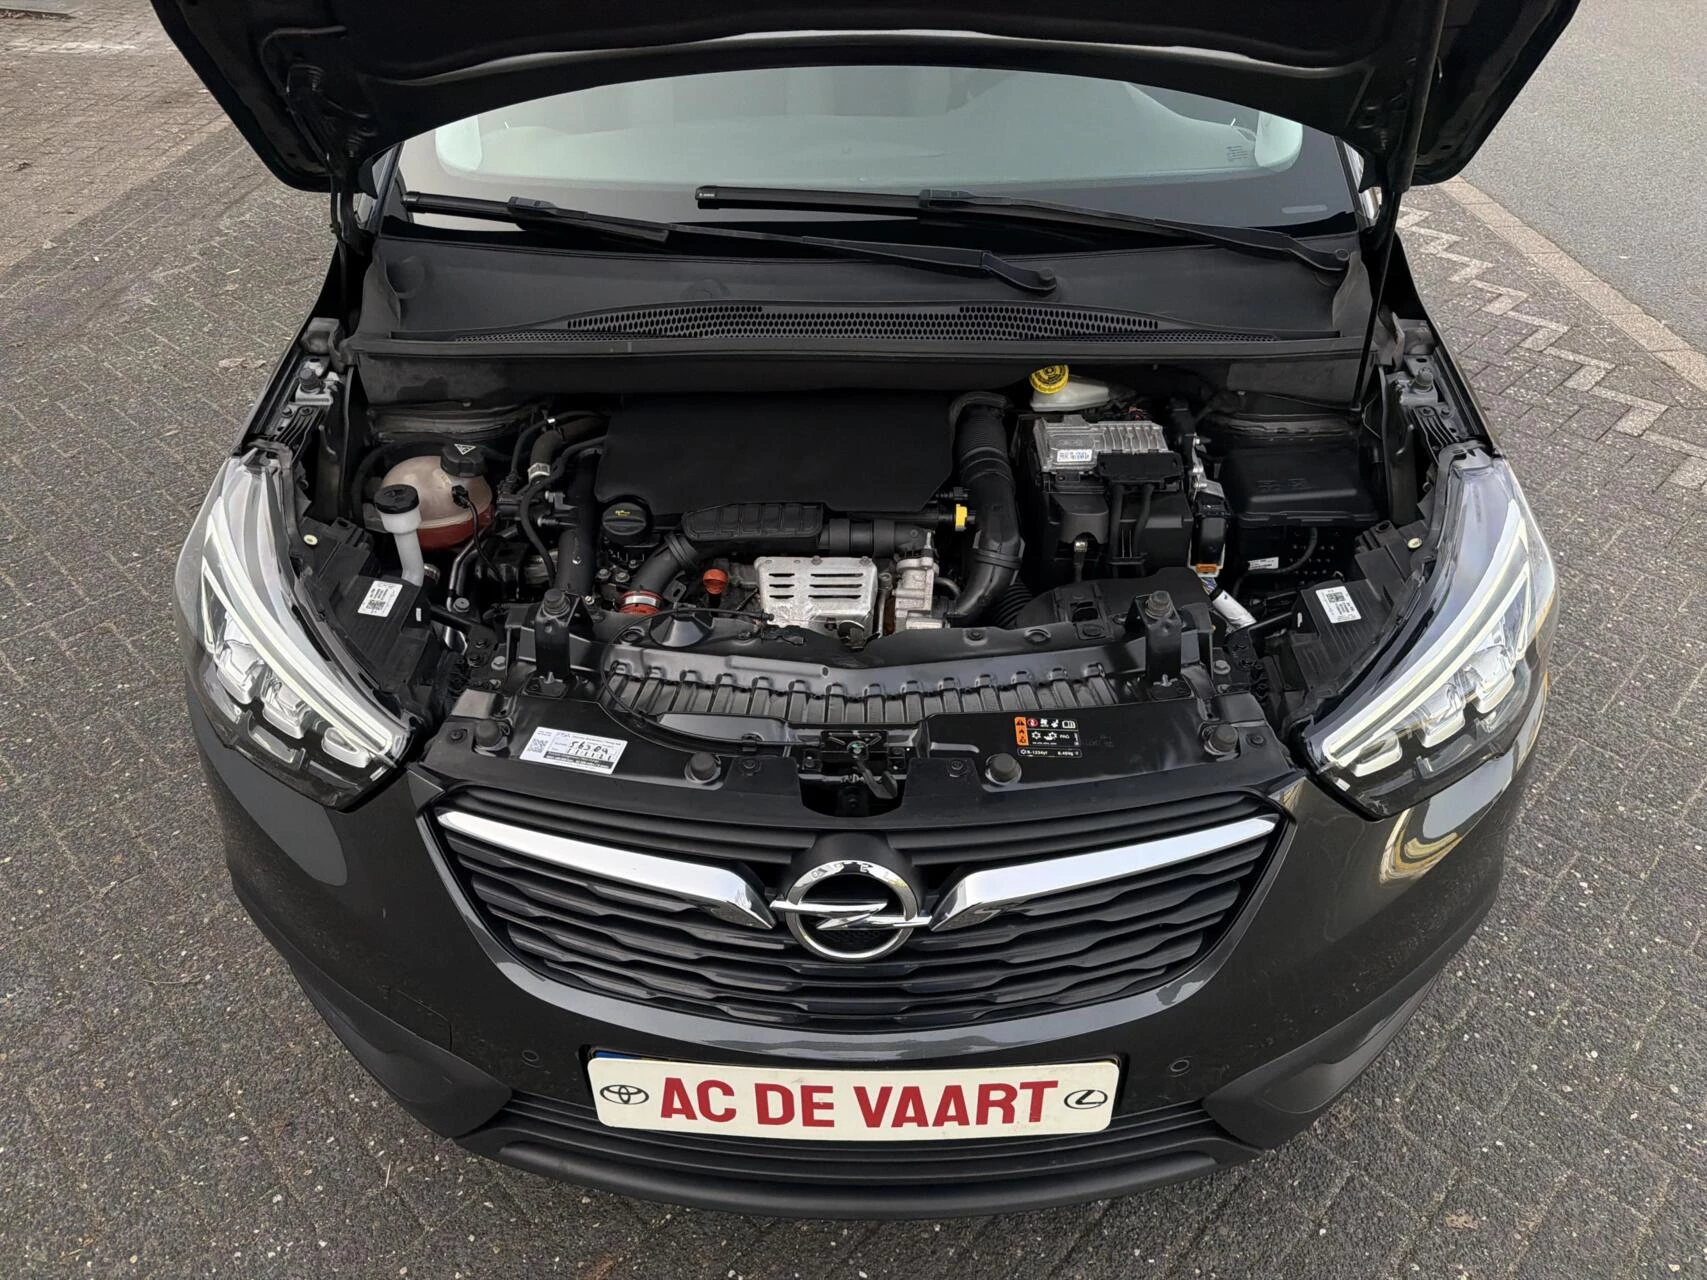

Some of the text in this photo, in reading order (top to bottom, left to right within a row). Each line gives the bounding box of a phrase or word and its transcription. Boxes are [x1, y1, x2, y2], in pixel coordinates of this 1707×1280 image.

[660, 1077, 1060, 1129] AC DE VAART
